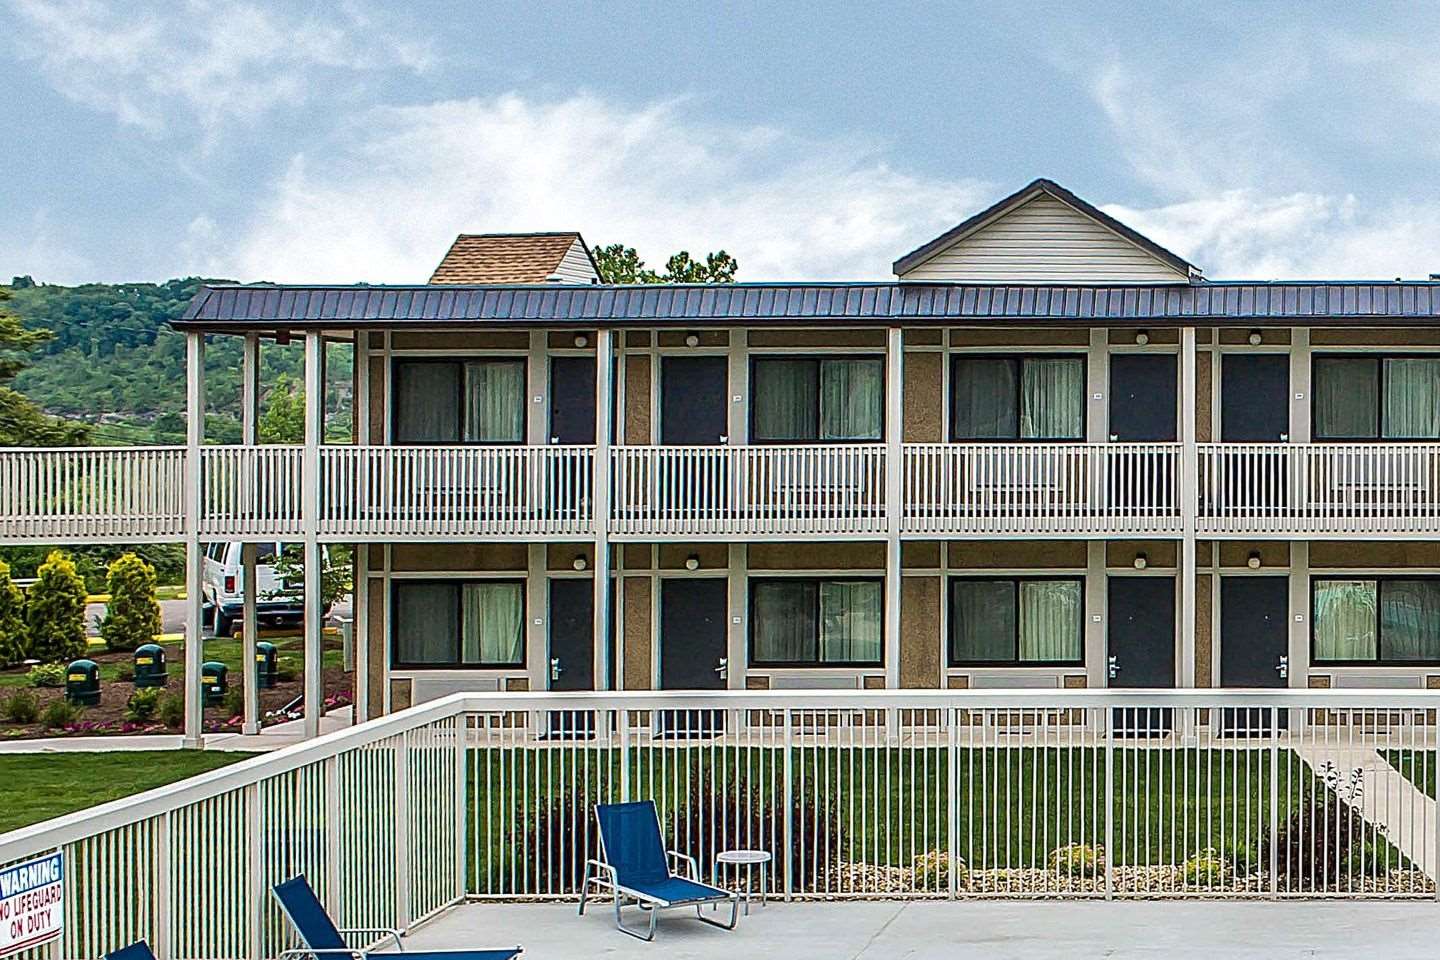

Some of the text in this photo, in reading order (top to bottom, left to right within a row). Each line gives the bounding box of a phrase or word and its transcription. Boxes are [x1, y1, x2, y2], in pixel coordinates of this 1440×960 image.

[0, 858, 59, 898] WARNING
[14, 884, 61, 916] LIFEGUARD
[10, 909, 51, 939] ON DUTY
